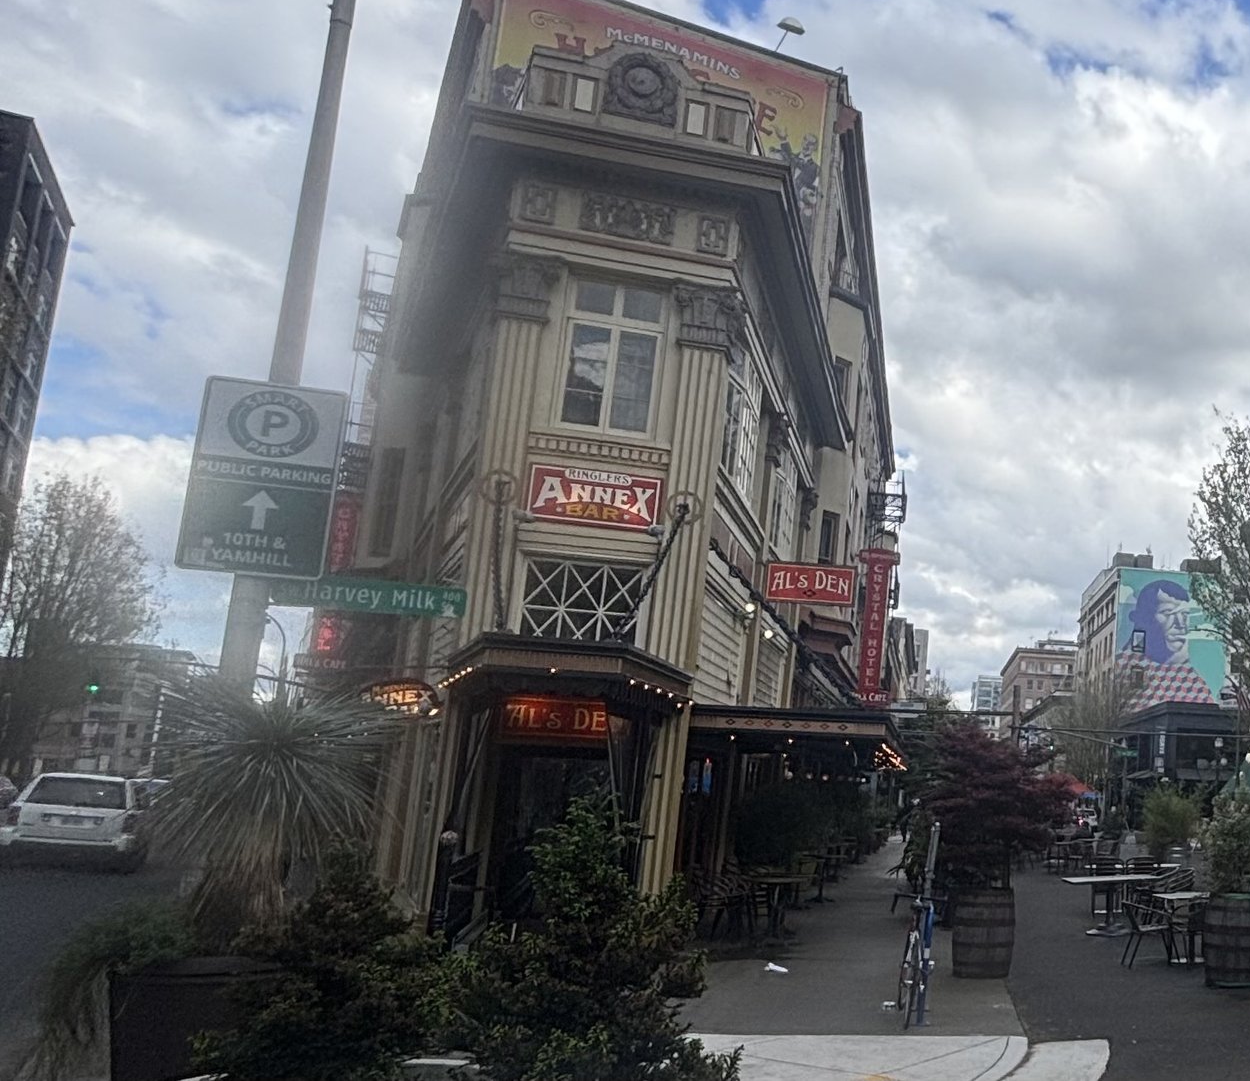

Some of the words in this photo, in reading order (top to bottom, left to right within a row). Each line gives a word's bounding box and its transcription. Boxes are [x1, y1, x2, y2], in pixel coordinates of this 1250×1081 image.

[245, 393, 309, 413] SMART
[260, 410, 290, 437] P
[246, 439, 294, 456] PARK
[197, 459, 256, 477] PUBLIC
[260, 467, 333, 484] PARKING
[568, 469, 630, 485] RINGLERS
[532, 476, 655, 522] ANNEX
[565, 504, 619, 520] BAR
[223, 532, 268, 547] 10TH
[272, 536, 287, 550] &
[211, 548, 292, 567] YAMHILL
[304, 581, 382, 609] Harvey
[392, 589, 435, 610] Milk
[815, 571, 849, 596] DEN
[870, 564, 883, 631] CRYSTAL
[864, 637, 877, 687] HOTEL
[573, 708, 608, 732] DE
